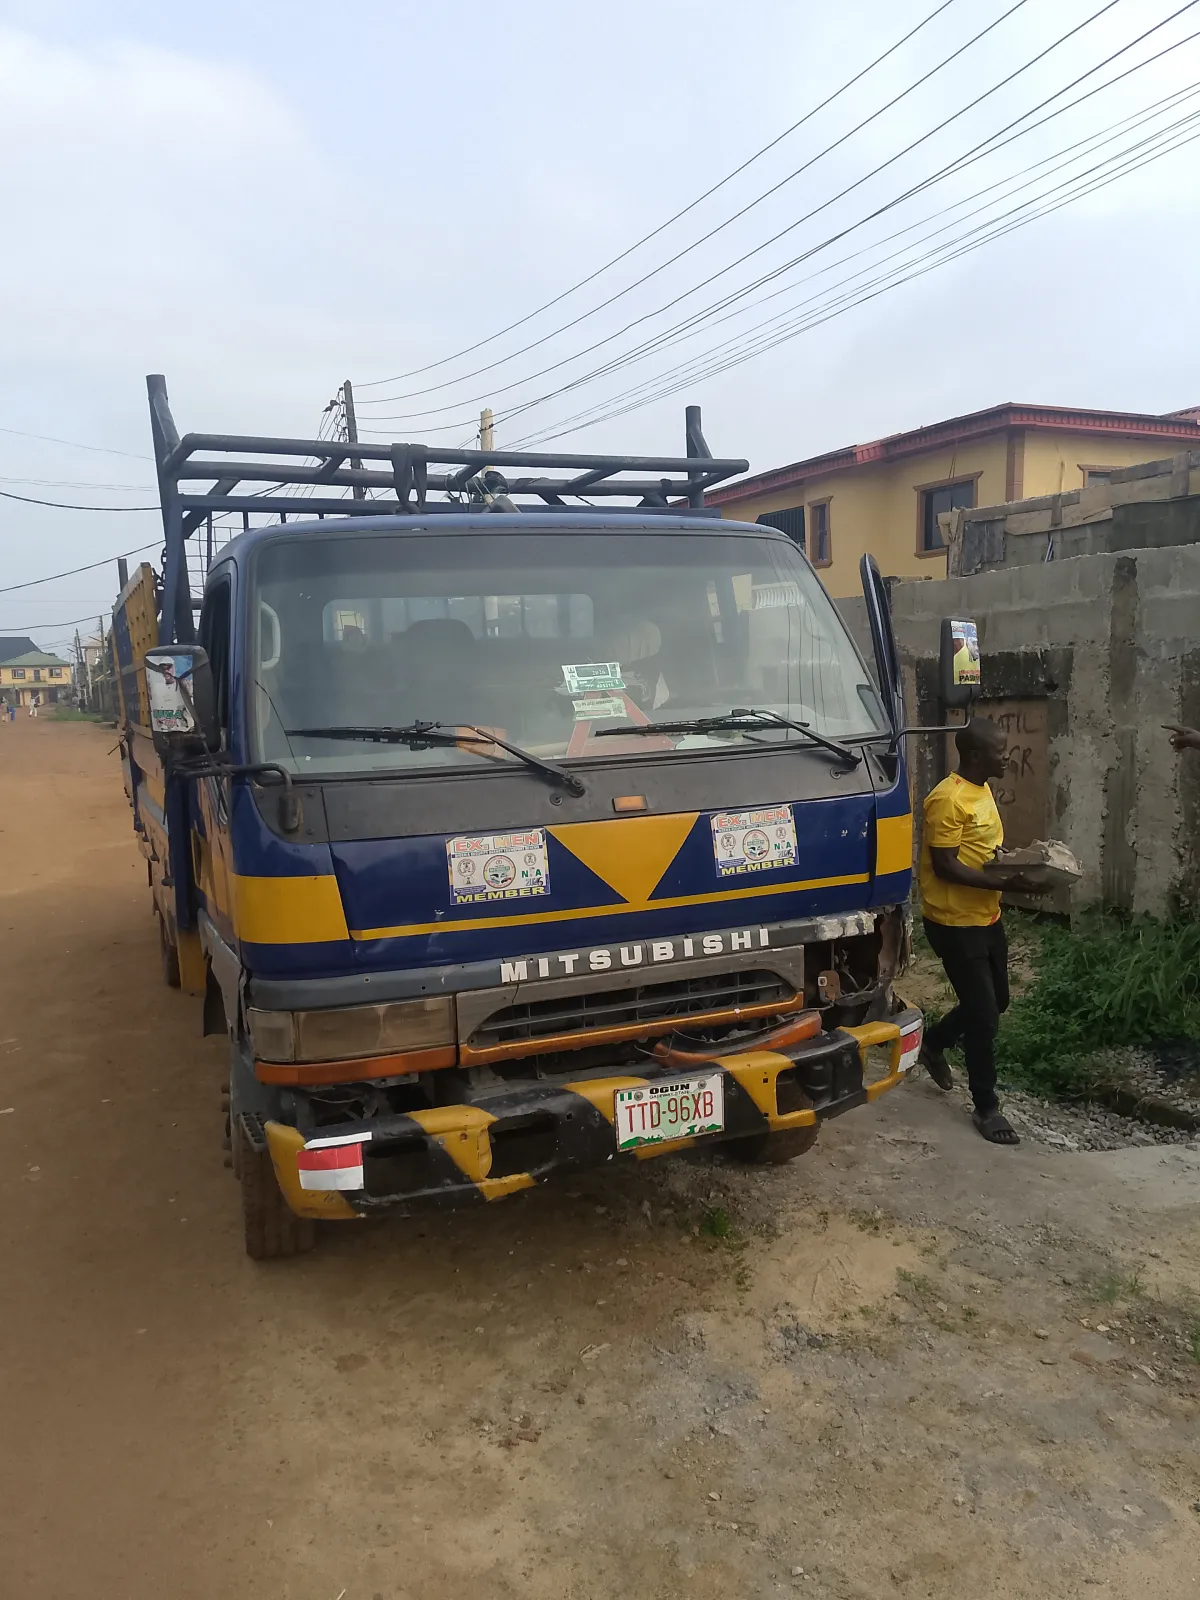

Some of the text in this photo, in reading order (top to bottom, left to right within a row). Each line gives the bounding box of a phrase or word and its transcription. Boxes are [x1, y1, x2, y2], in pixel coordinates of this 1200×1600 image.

[717, 808, 788, 829] EX. MEN
[454, 832, 540, 853] EX. MEN
[721, 857, 795, 876] MEMBER
[456, 886, 545, 904] MEMBER
[500, 928, 770, 984] MITSUBISHI
[649, 1083, 690, 1095] OGUN
[625, 1090, 714, 1133] TTD-96XB
